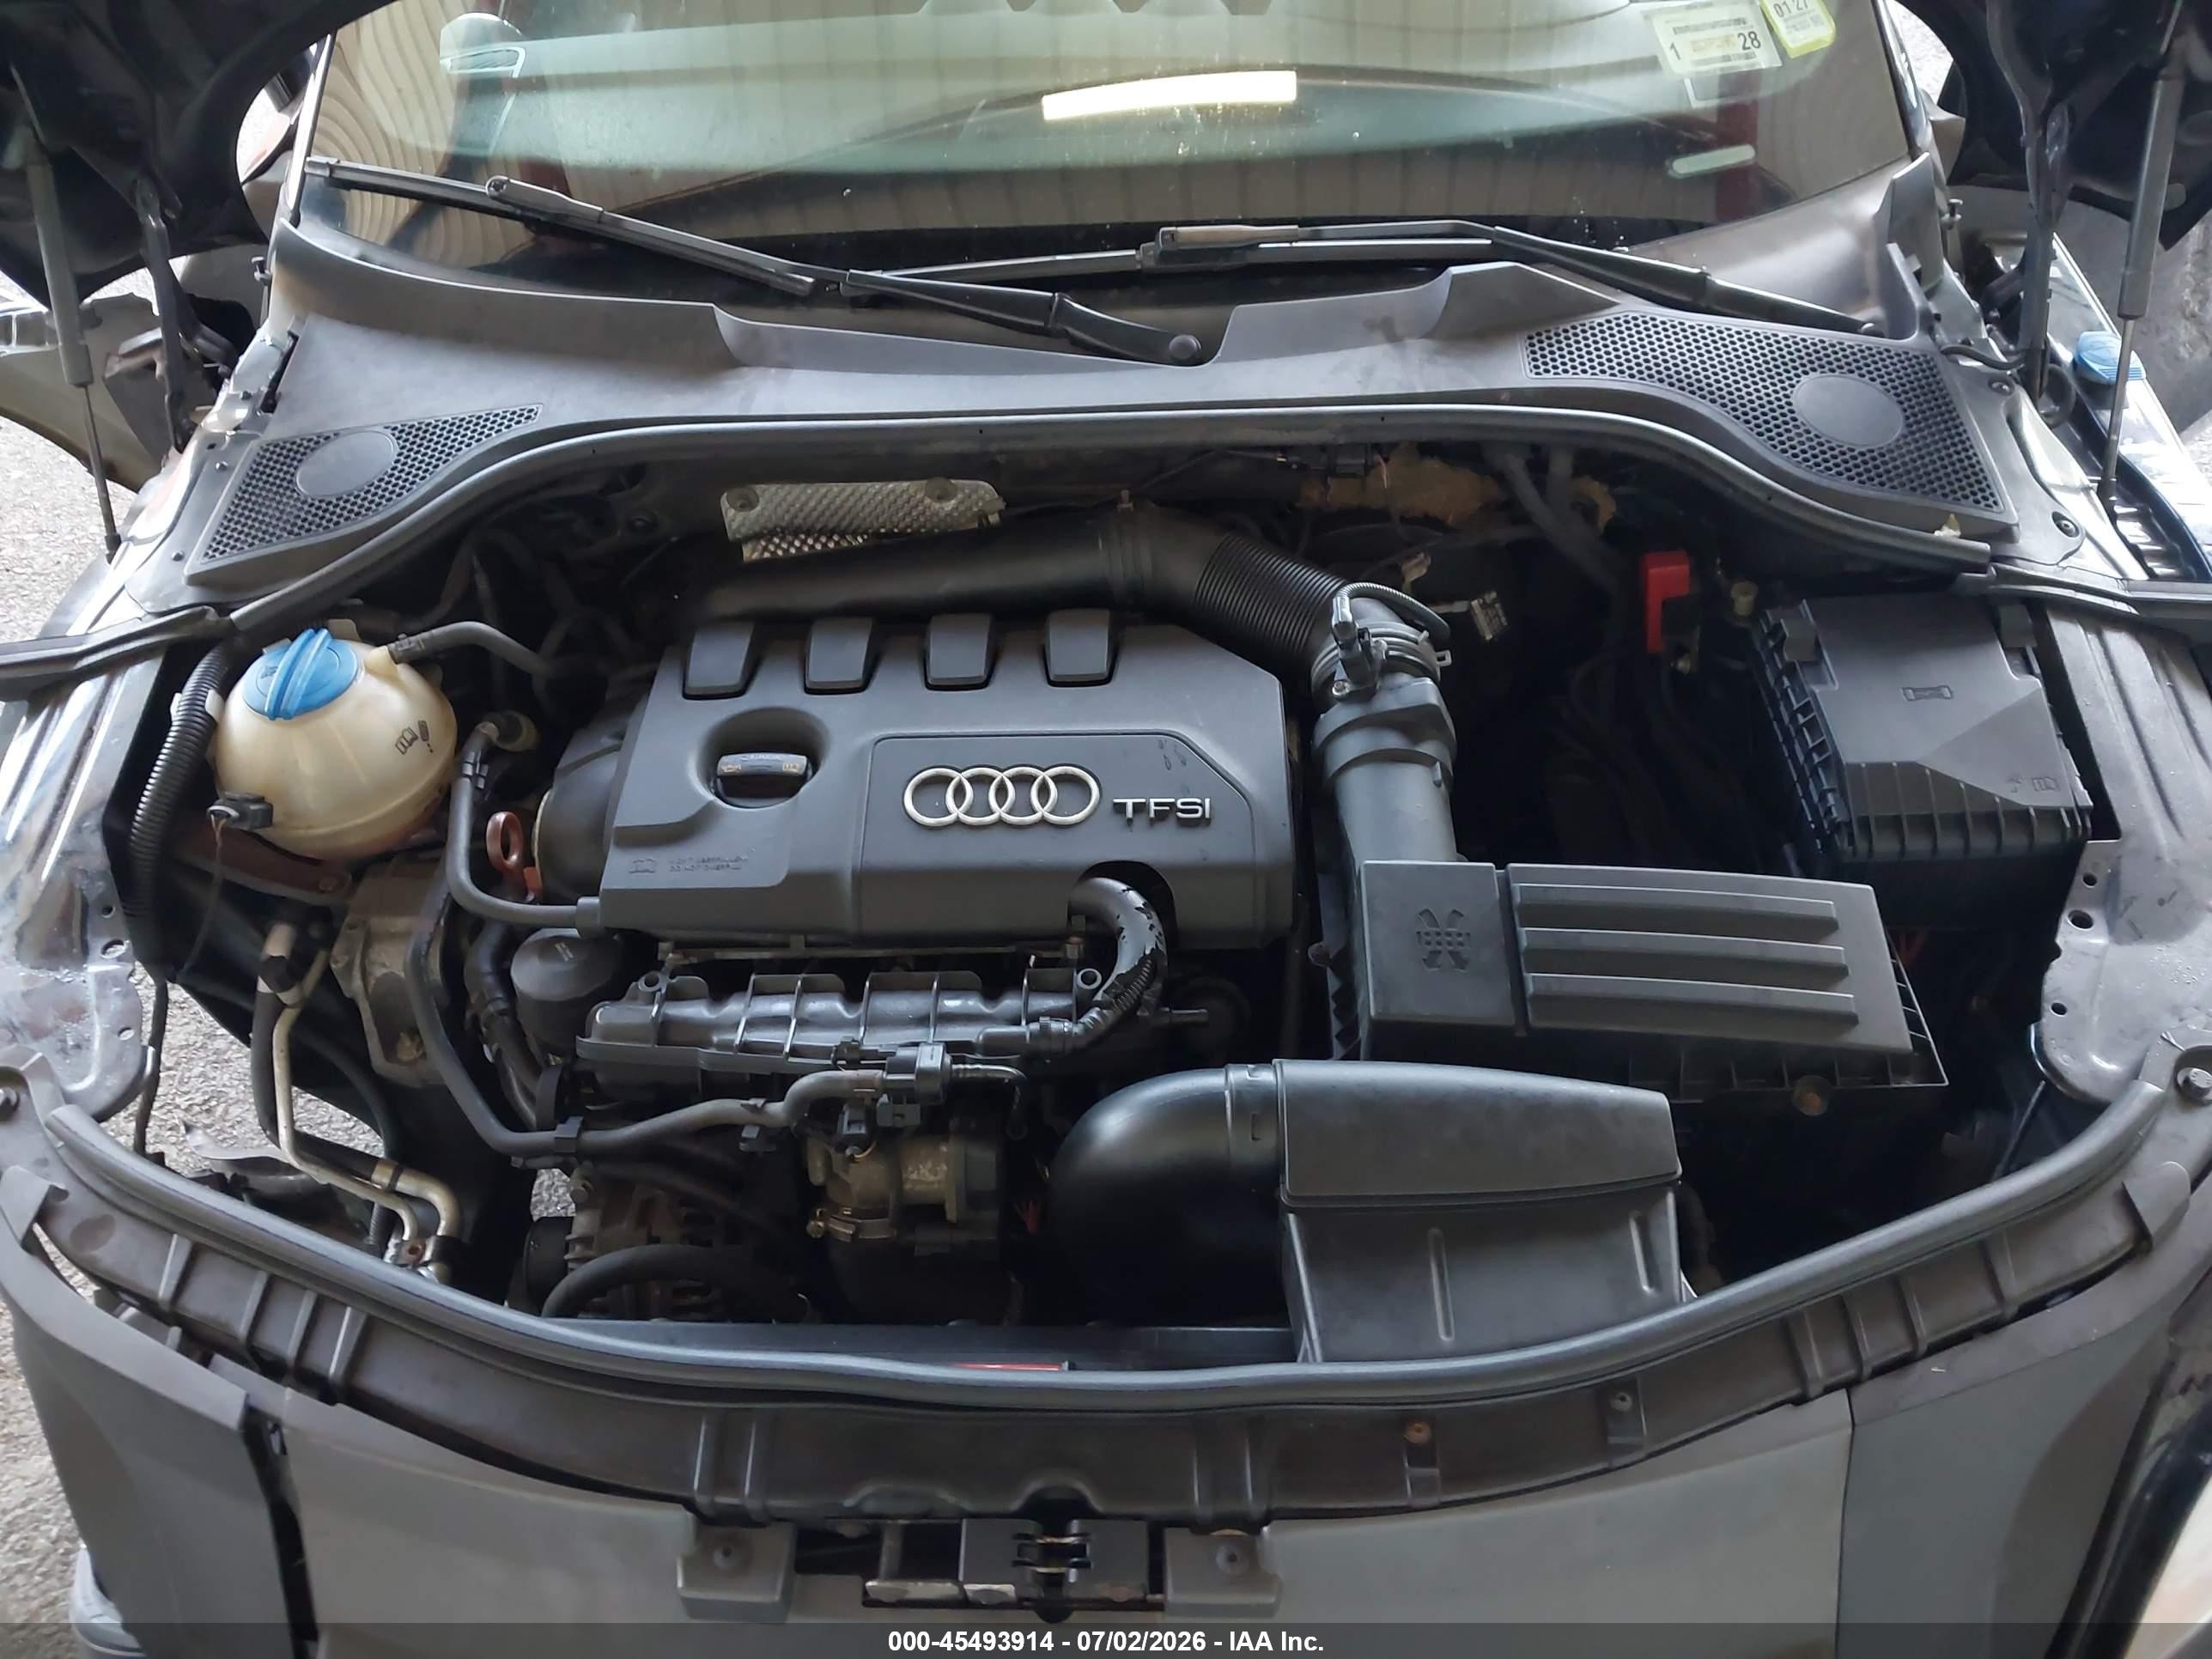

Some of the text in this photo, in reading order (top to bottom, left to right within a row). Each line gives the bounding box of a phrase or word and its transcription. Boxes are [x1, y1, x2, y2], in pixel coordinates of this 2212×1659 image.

[1773, 1, 1791, 17] 01
[1737, 31, 1761, 51] 28
[1113, 797, 1211, 818] TFSI
